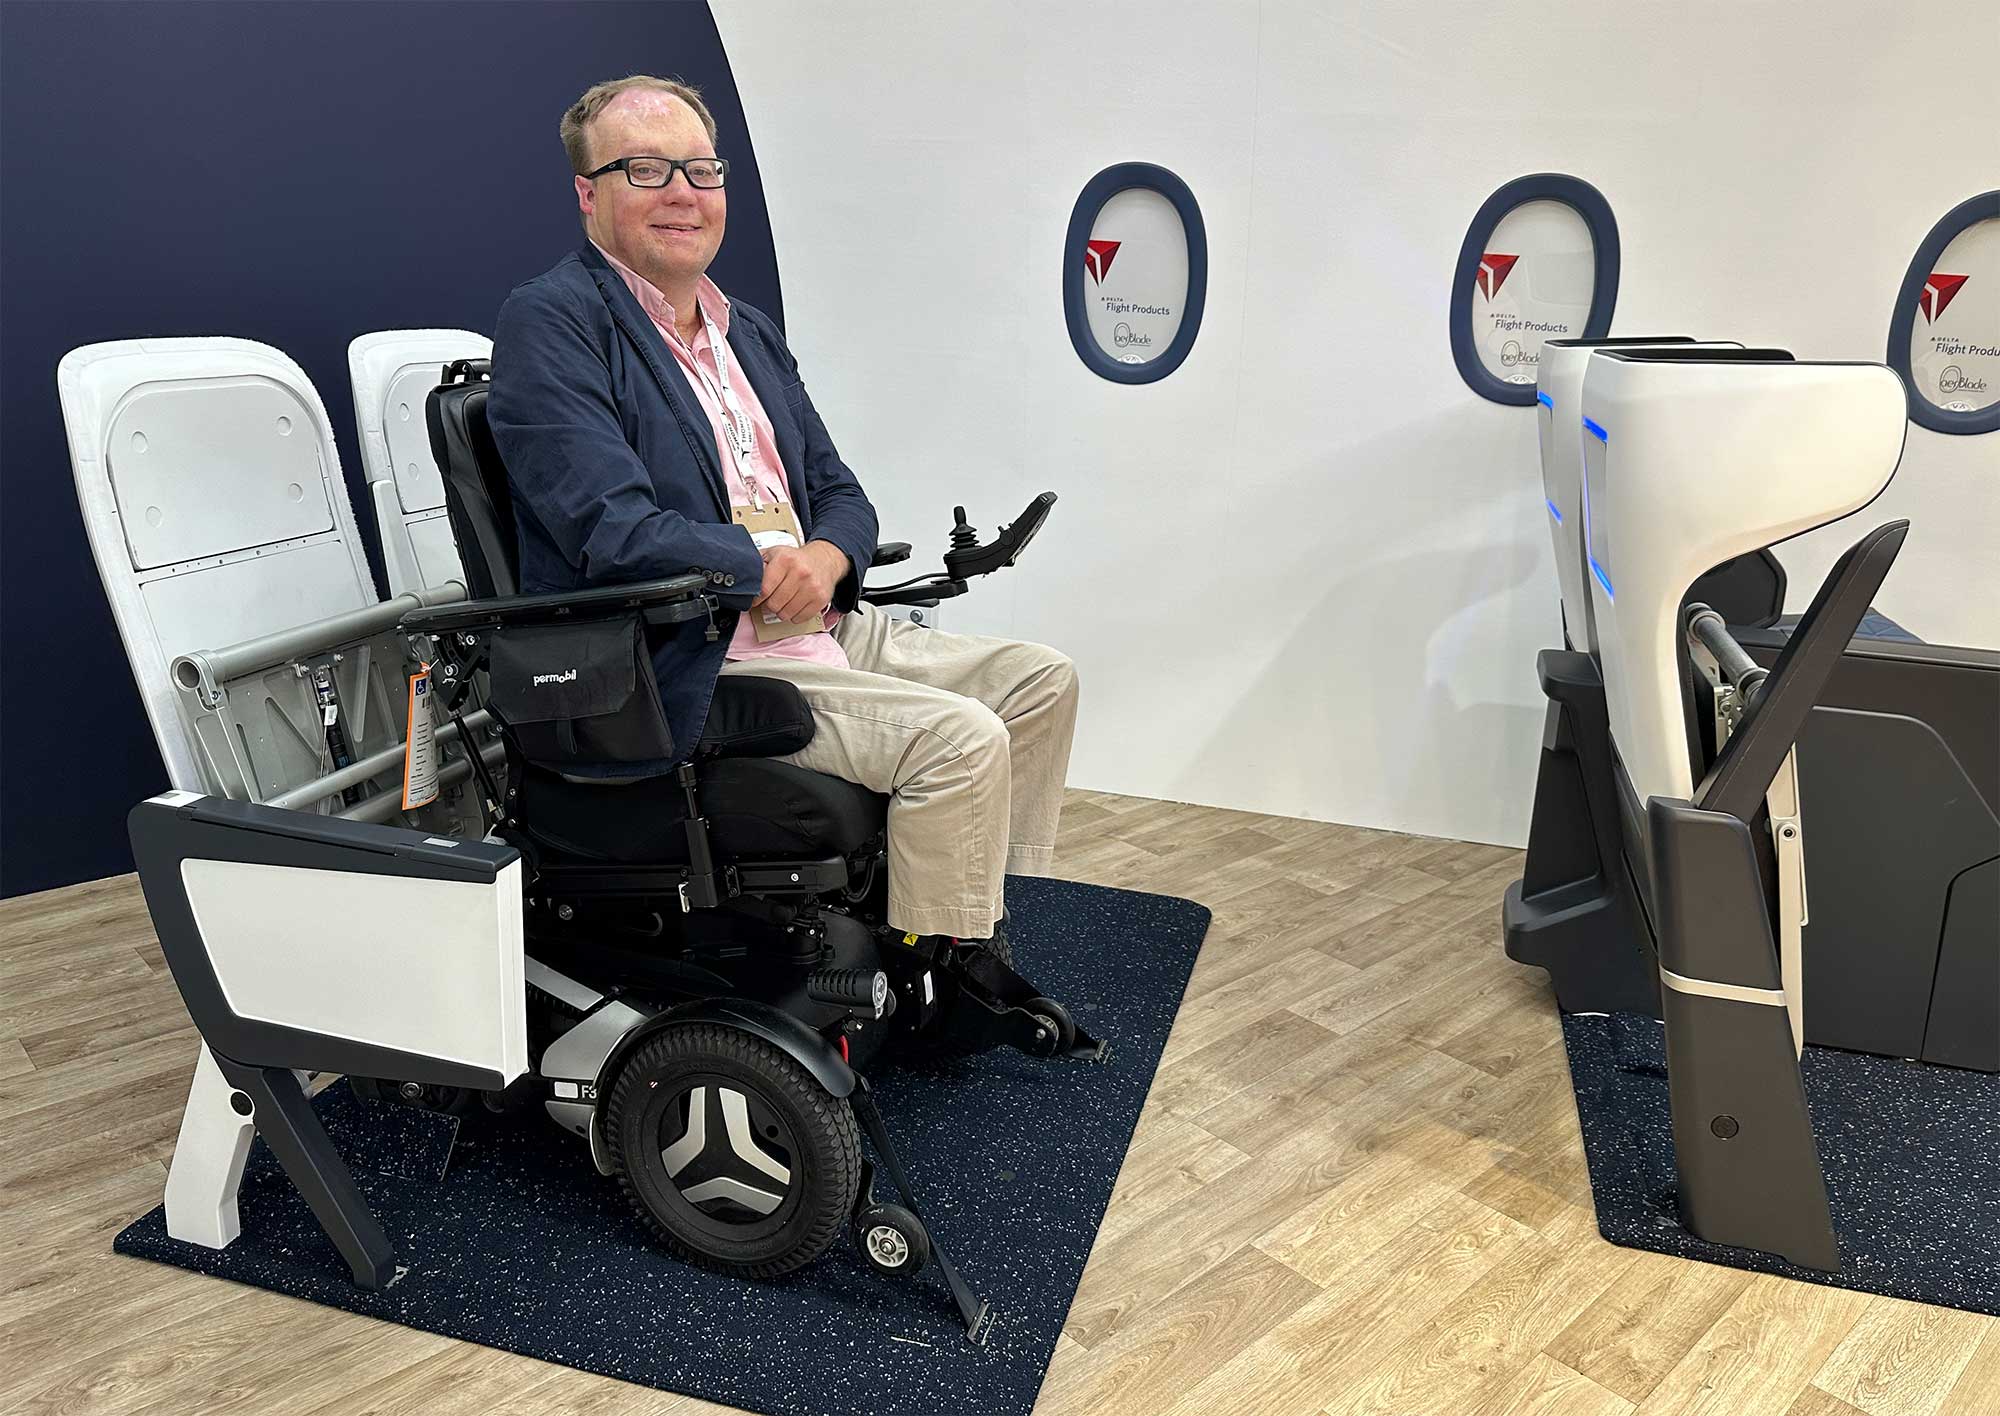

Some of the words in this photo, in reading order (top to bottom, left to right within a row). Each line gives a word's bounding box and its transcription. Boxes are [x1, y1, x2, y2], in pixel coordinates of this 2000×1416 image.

[1106, 302, 1130, 313] Flight
[1132, 304, 1170, 315] Products
[1495, 319, 1522, 331] Flight
[1524, 321, 1568, 333] Products
[1935, 342, 1966, 355] Flight
[1968, 345, 2000, 356] Produ
[533, 669, 577, 687] permobil
[581, 1085, 597, 1099] F3
